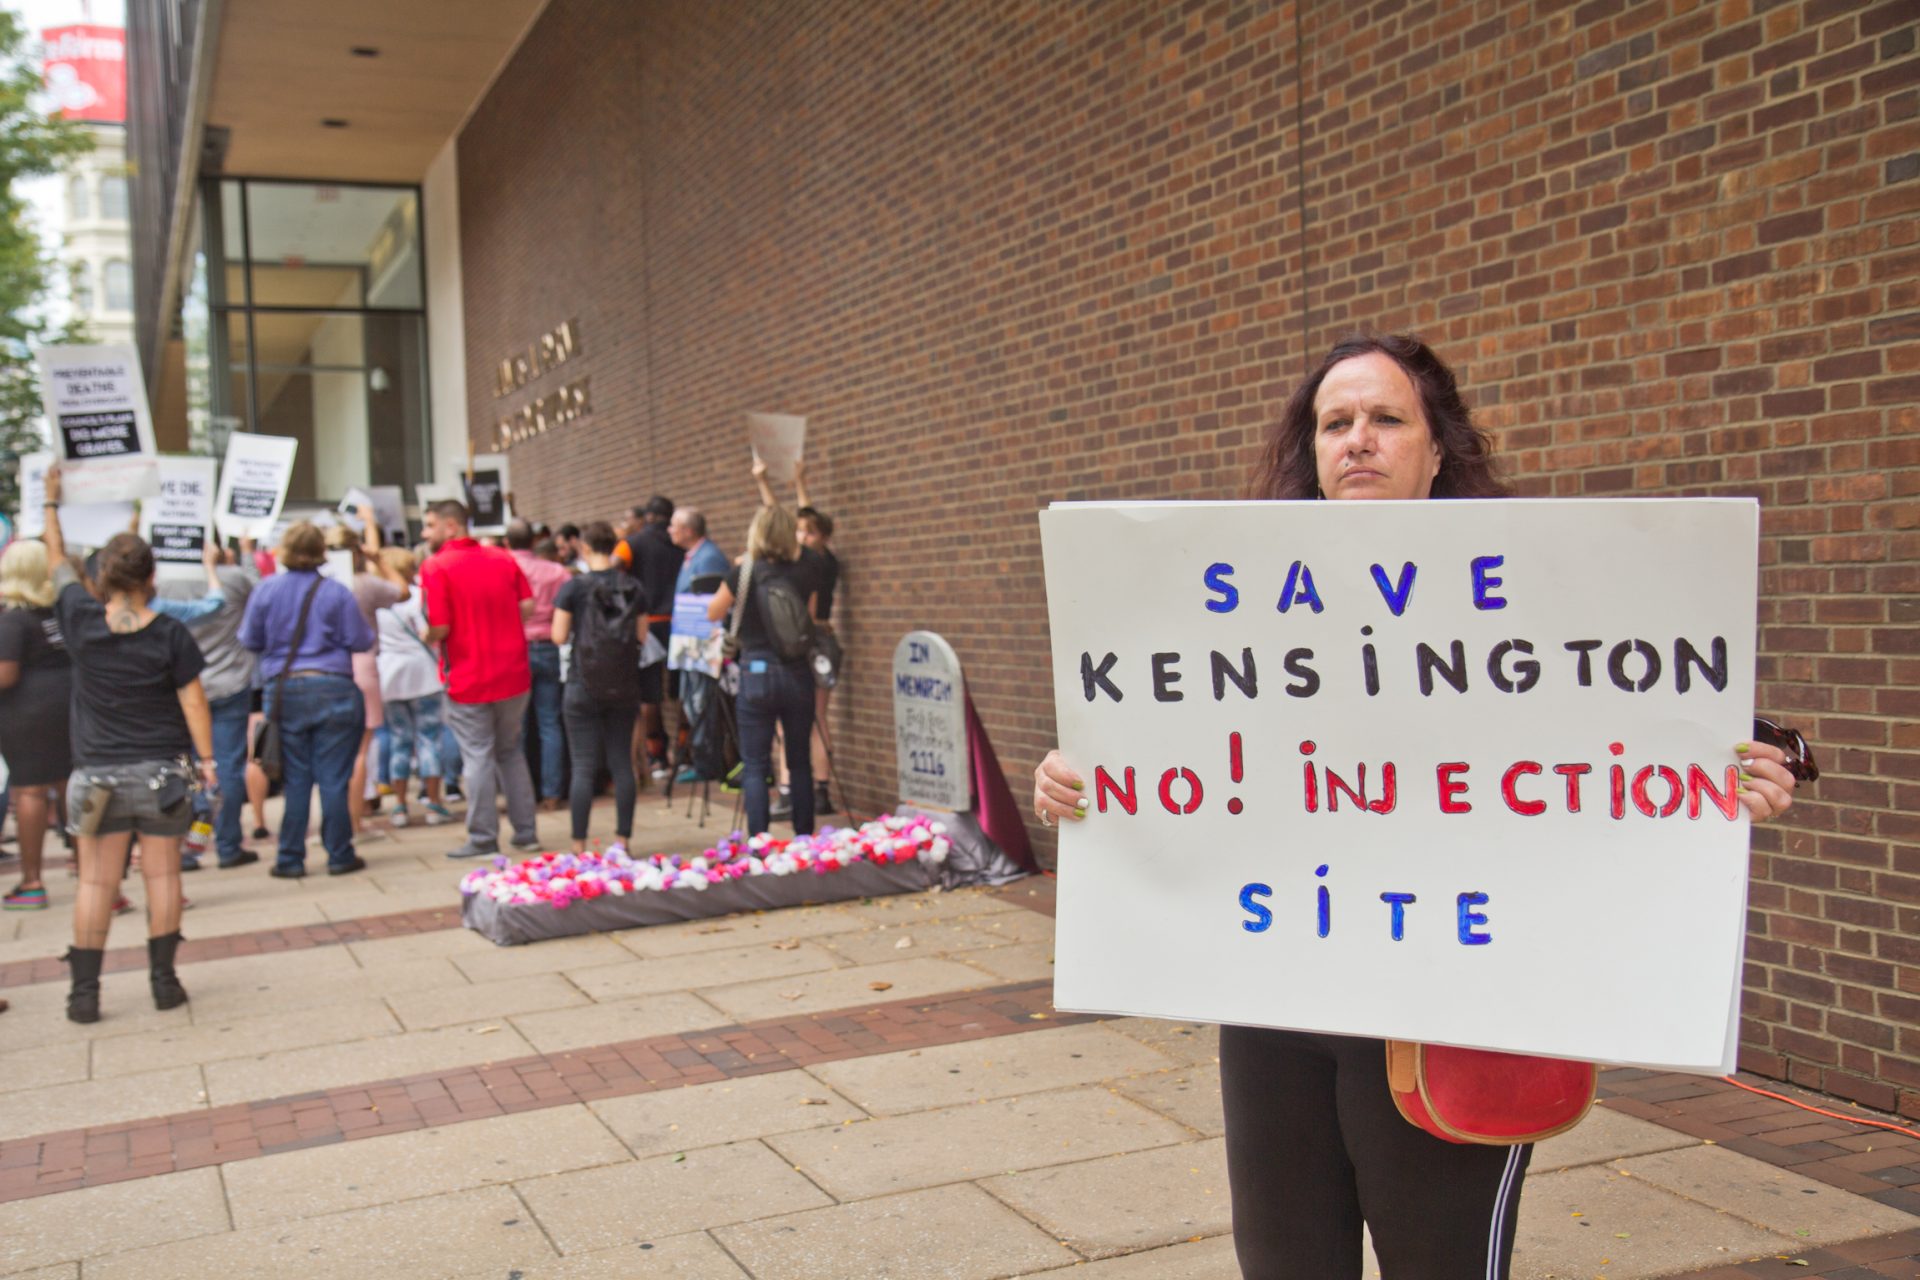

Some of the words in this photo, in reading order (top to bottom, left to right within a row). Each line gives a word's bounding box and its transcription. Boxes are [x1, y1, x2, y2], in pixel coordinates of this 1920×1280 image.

[1203, 555, 1508, 617] SAVE
[909, 642, 930, 664] IN
[1094, 730, 1246, 816] NO!
